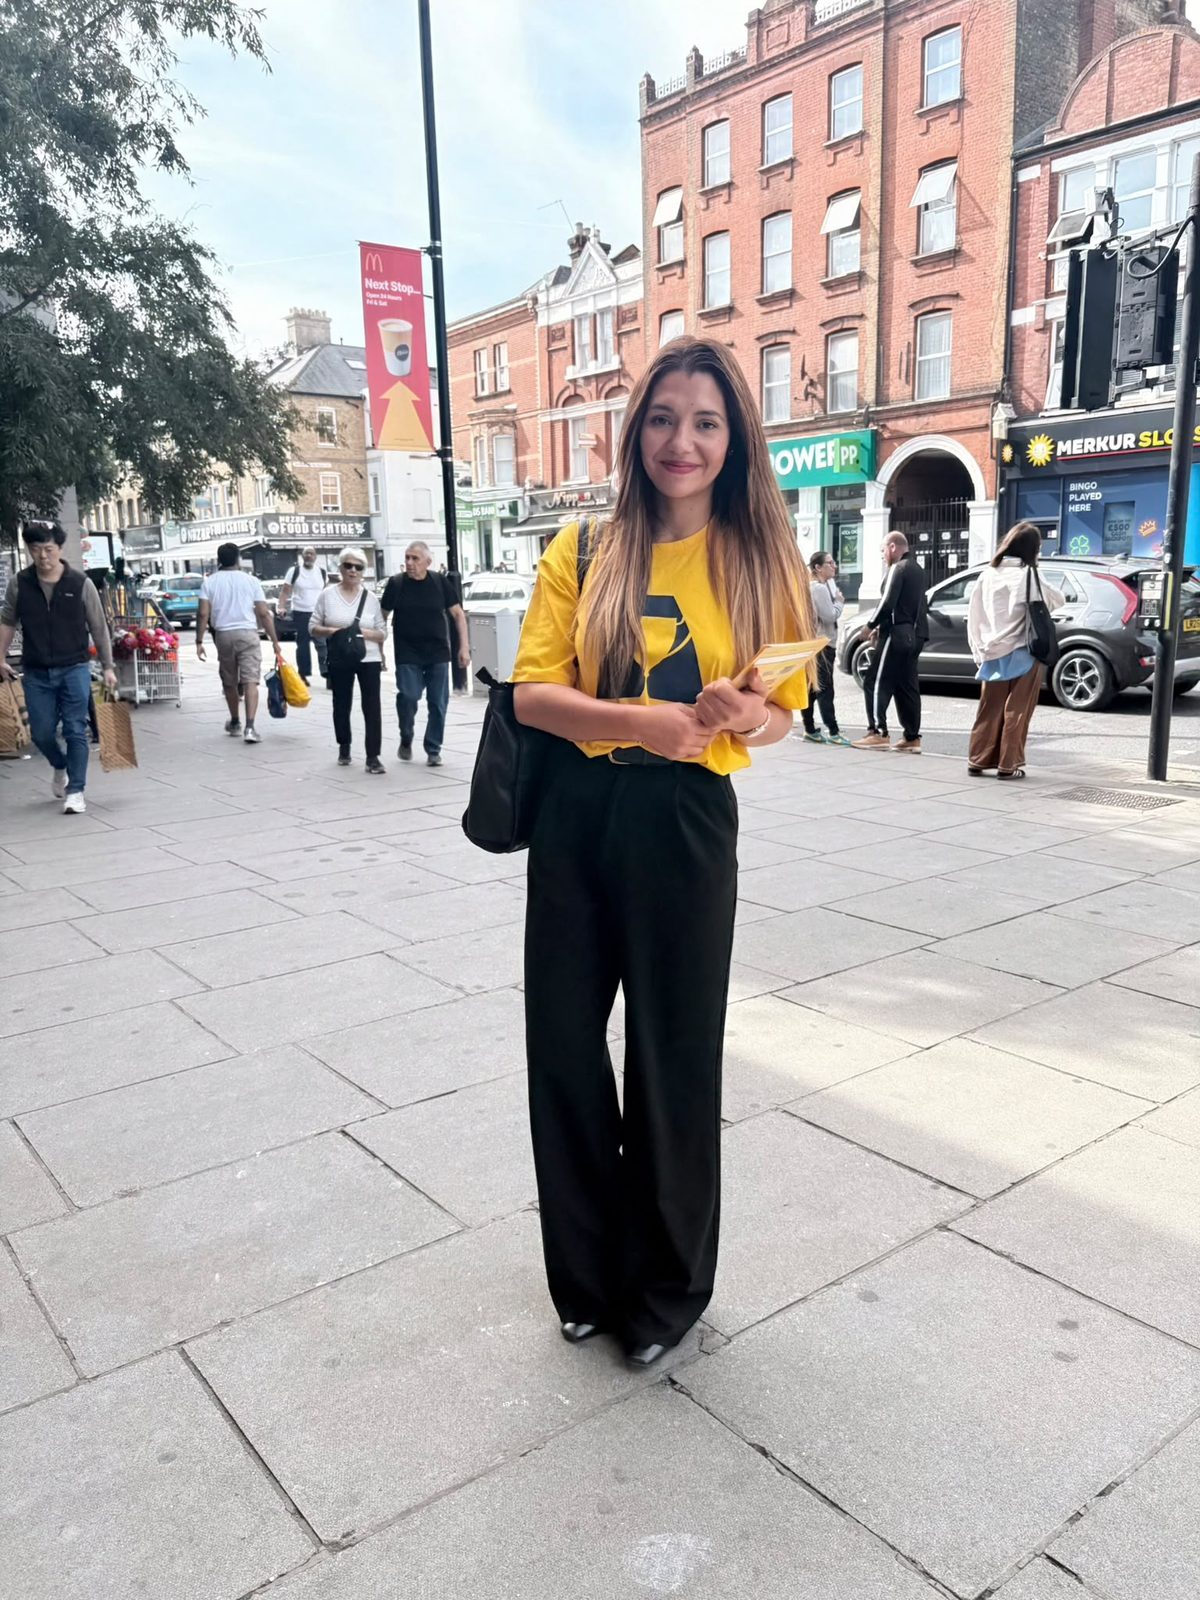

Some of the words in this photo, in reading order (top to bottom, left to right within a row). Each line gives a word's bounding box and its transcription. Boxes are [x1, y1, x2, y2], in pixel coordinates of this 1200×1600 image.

[364, 277, 389, 290] Next
[1056, 433, 1136, 456] MERKUR
[1069, 481, 1098, 491] BINGO
[1069, 492, 1102, 502] PLAYED
[1068, 503, 1092, 512] HERE
[279, 523, 310, 535] FOOD
[311, 523, 354, 535] CENTRE
